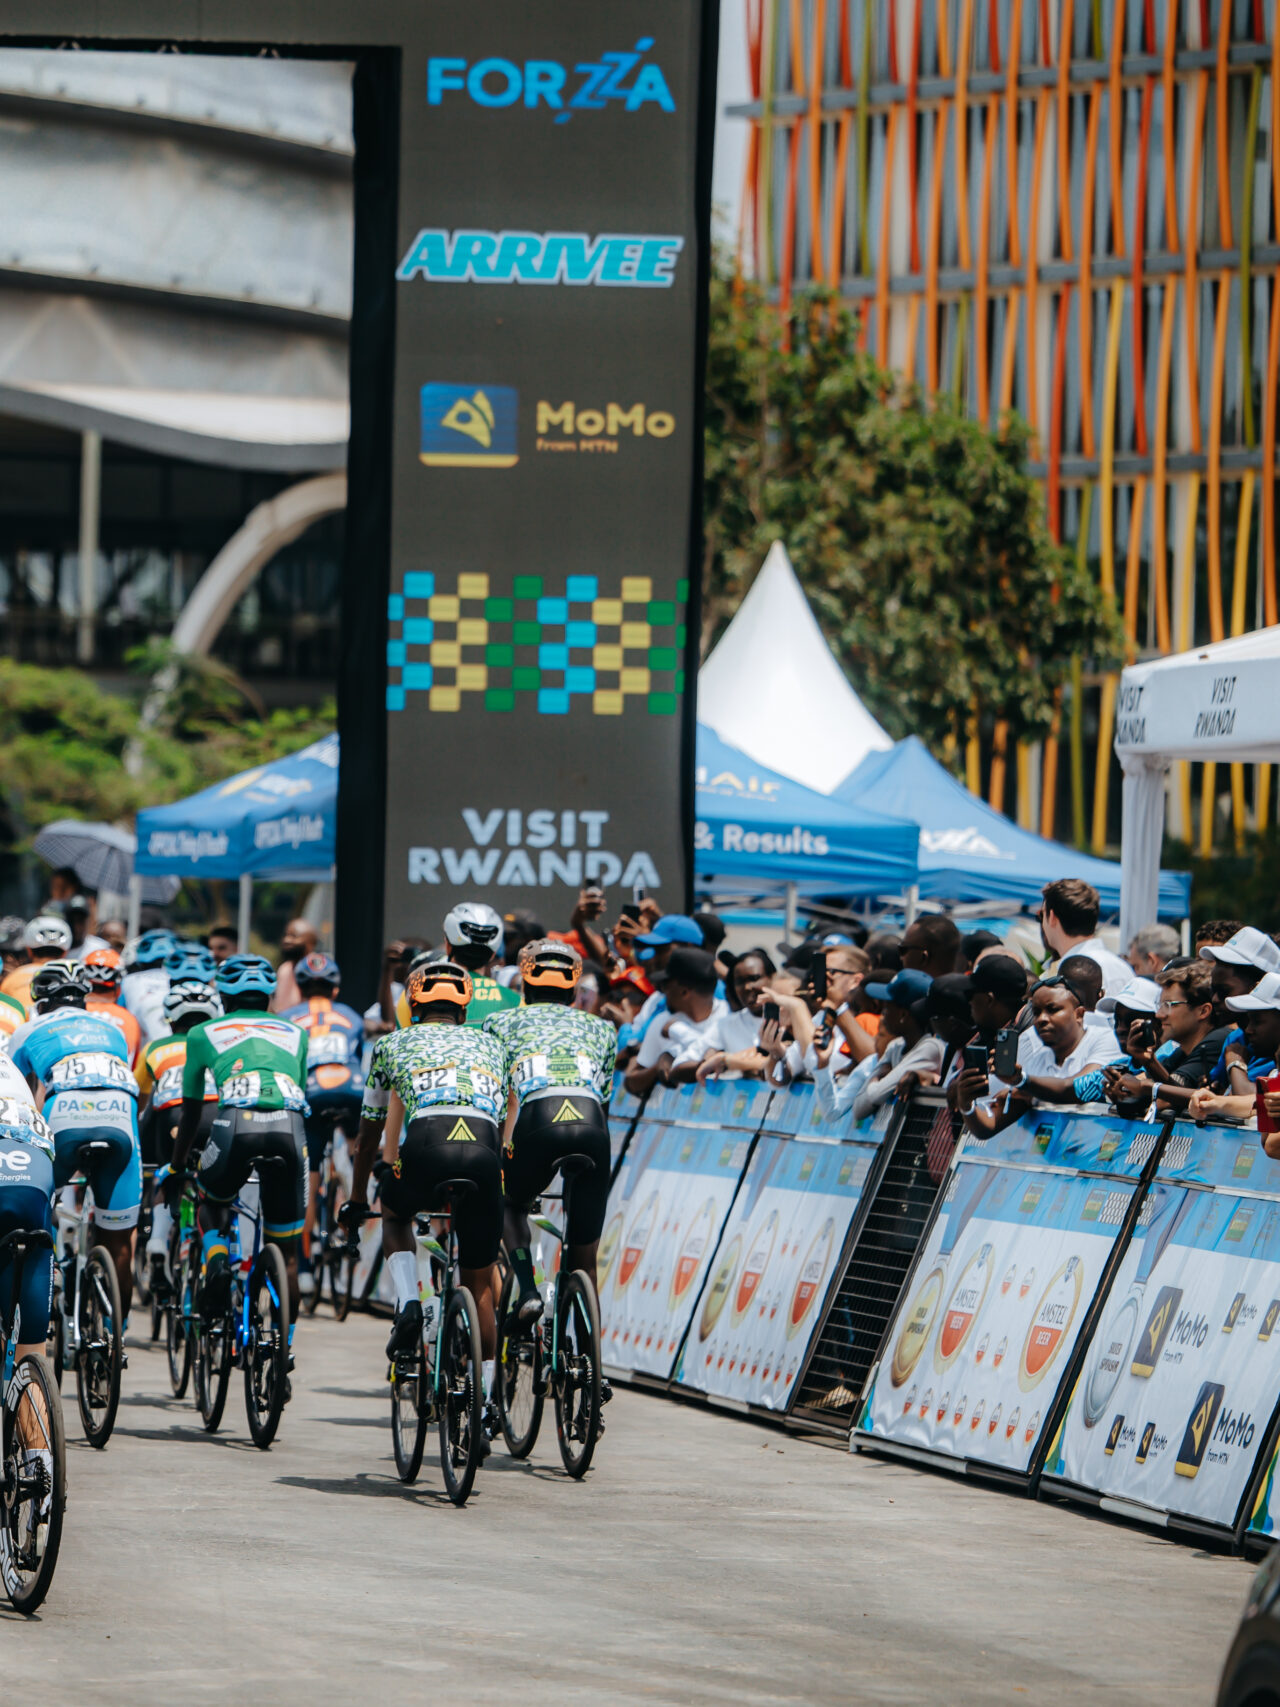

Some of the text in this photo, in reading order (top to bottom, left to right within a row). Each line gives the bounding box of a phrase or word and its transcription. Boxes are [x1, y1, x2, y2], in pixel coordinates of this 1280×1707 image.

[396, 227, 684, 288] ARRIVEE
[536, 400, 676, 438] MoMo
[536, 438, 618, 453] from MTN
[1211, 676, 1237, 705] VISIT
[1194, 708, 1236, 738] RWANDA
[461, 808, 610, 848] VISIT
[723, 823, 829, 856] Results
[407, 847, 662, 888] RWANDA
[419, 1068, 448, 1091] 32
[58, 1100, 128, 1113] PASCAL
[1039, 1303, 1069, 1325] AMSTEL
[1170, 1310, 1209, 1349] MoMo
[1036, 1331, 1051, 1346] BEER
[1213, 1407, 1255, 1449] MoMo
